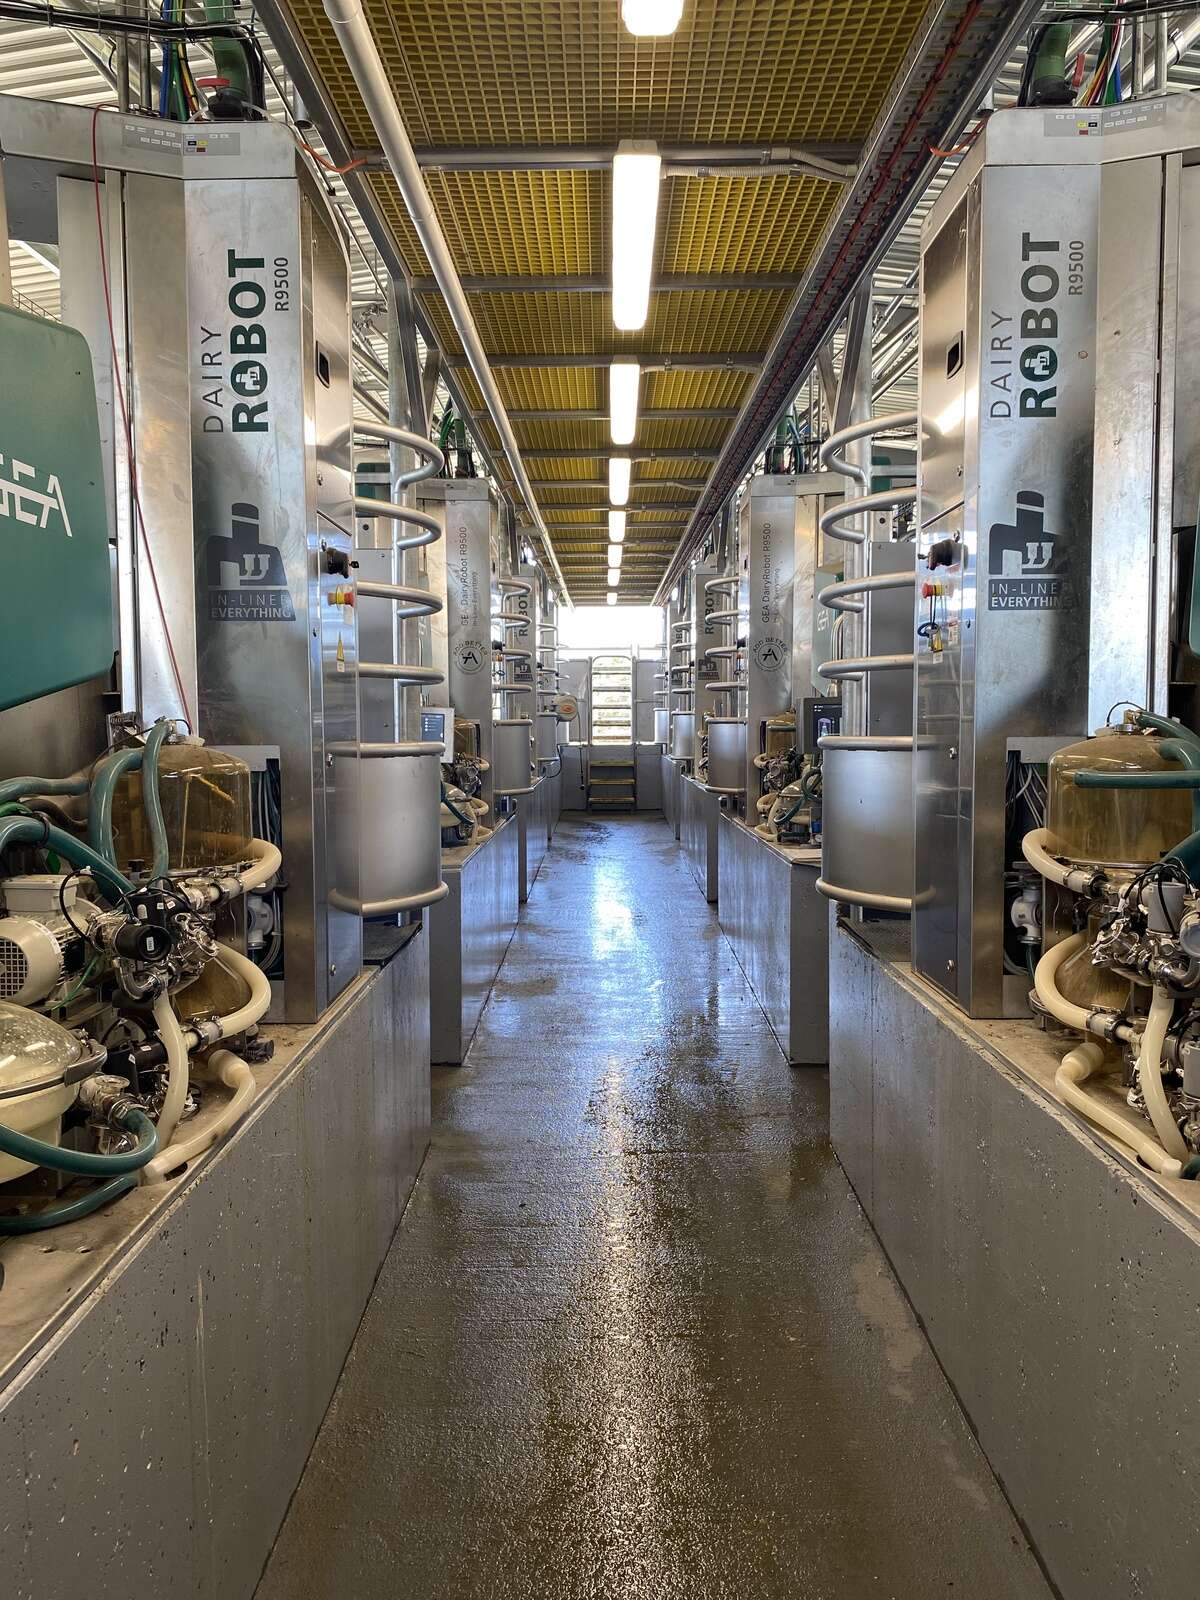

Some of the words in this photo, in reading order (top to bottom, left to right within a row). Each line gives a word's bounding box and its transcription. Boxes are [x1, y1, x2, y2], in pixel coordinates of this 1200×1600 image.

[274, 257, 289, 311] R9500
[1068, 240, 1084, 295] R9500
[227, 249, 269, 432] ROBOT
[1018, 232, 1060, 417] ROBOT
[200, 326, 223, 433] DAIRY
[990, 311, 1013, 417] DAIRY
[458, 527, 468, 556] R9500
[761, 523, 771, 552] R9500
[459, 558, 470, 606] DairyRobot
[761, 554, 772, 603] DairyRobot
[211, 607, 291, 618] EVERYTHING
[761, 605, 770, 623] GEA
